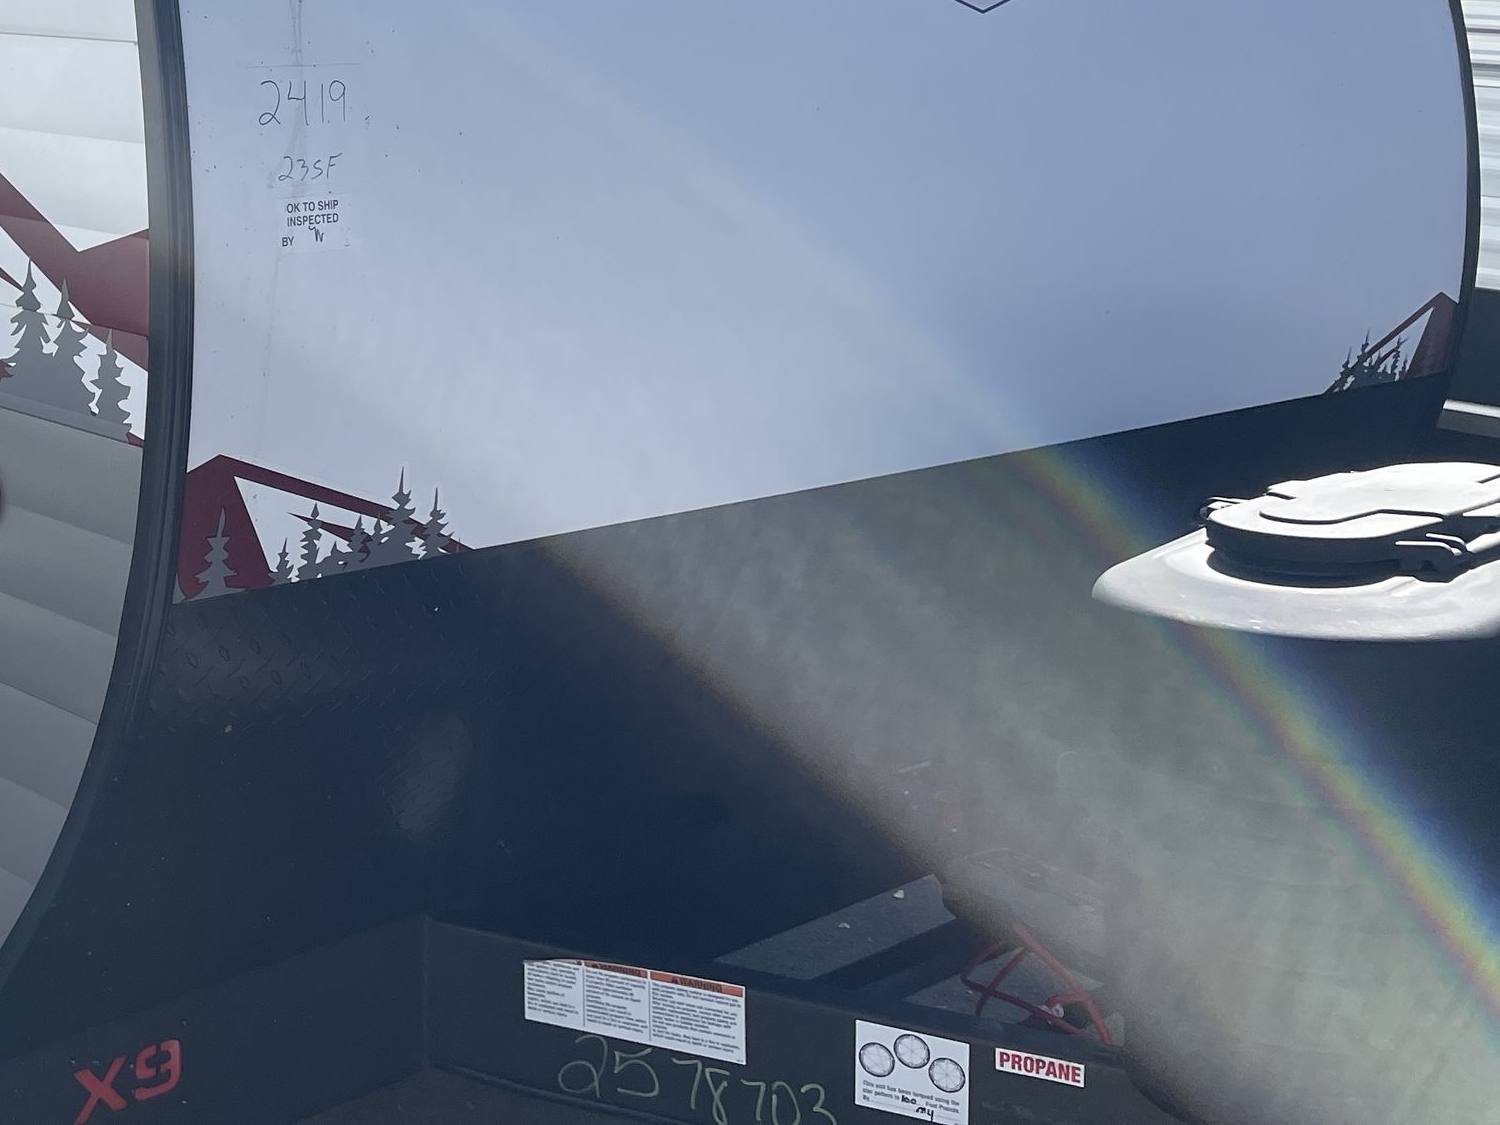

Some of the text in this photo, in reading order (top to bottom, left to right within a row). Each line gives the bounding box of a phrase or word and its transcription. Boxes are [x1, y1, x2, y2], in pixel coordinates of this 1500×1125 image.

[258, 79, 347, 127] 2419
[286, 199, 339, 214] OK TO SHIP
[287, 213, 339, 227] INSPECTED
[282, 236, 294, 248] BY
[998, 1051, 1082, 1084] PROPANE
[74, 1038, 182, 1125] X9
